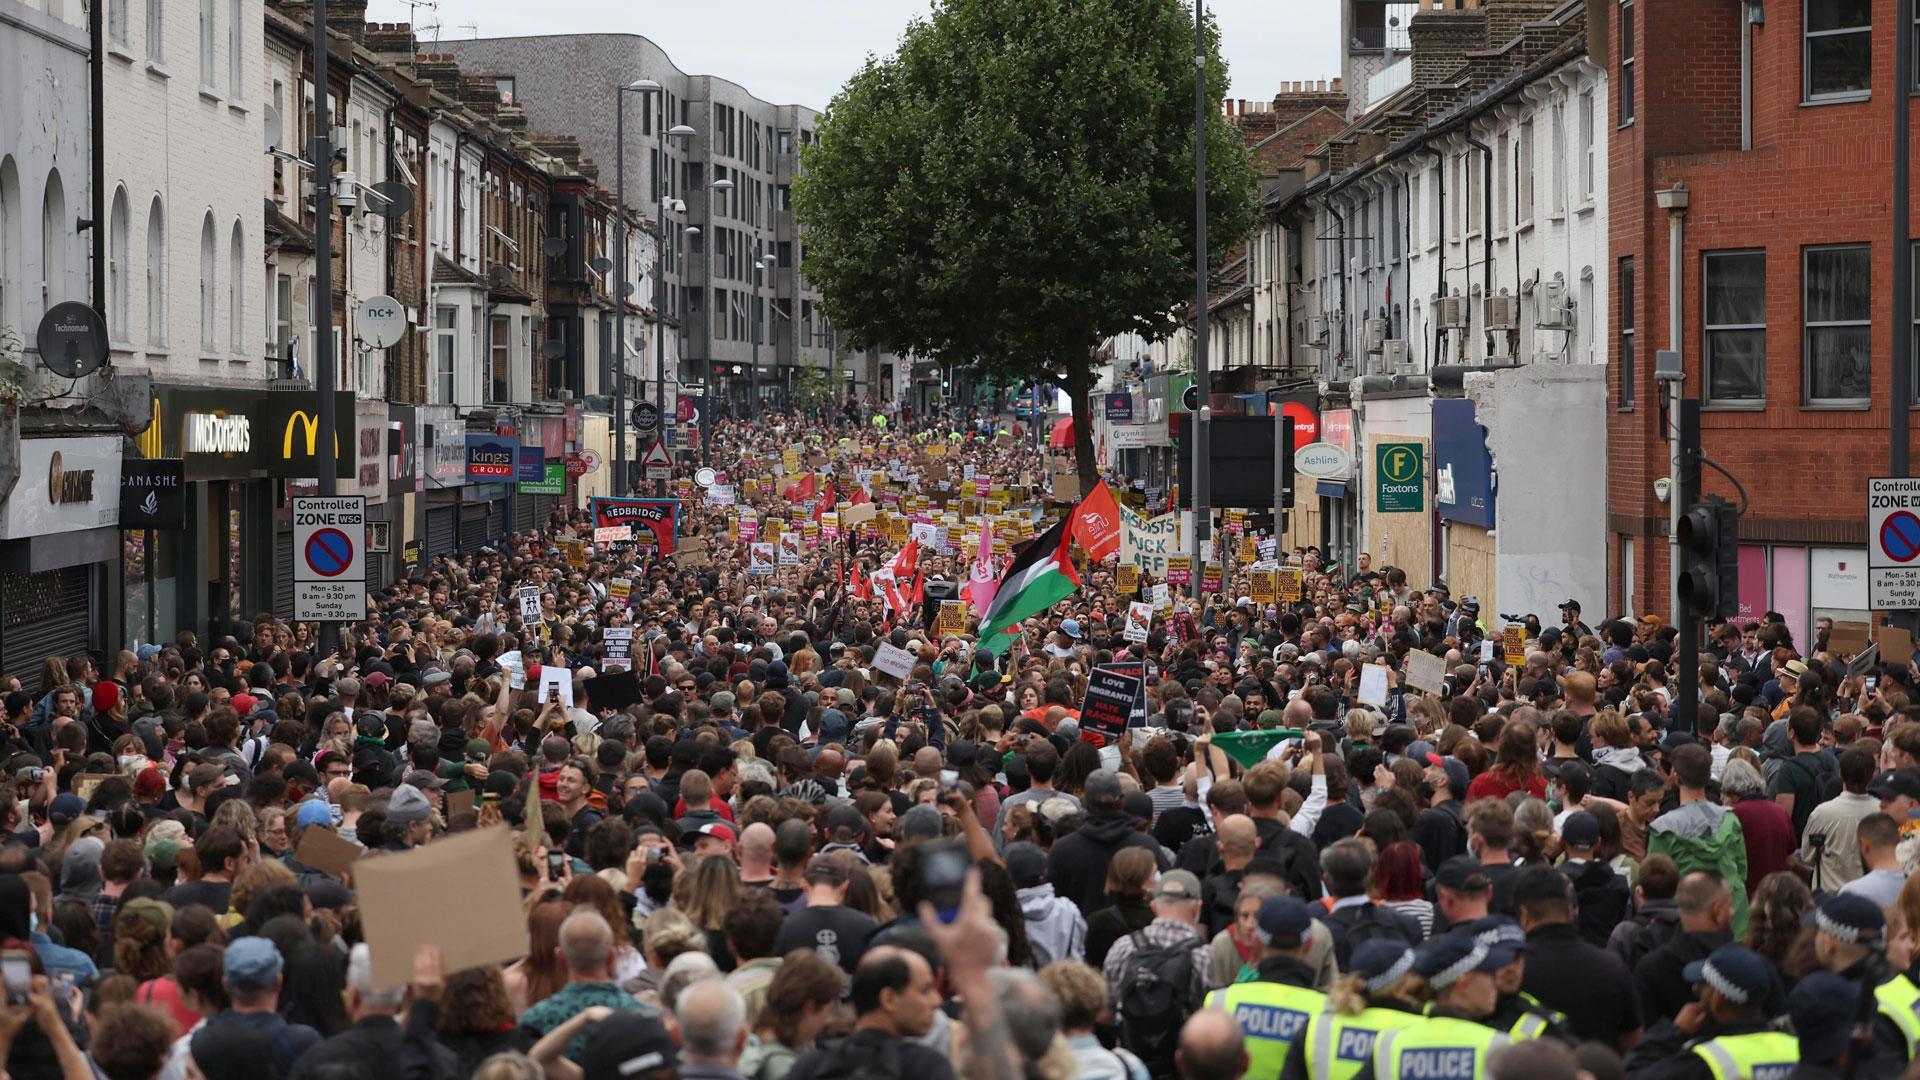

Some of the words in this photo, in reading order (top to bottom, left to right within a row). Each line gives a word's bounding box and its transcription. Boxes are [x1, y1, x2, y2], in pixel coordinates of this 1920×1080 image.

[368, 308, 394, 317] nc+
[55, 323, 89, 332] Technomate
[194, 413, 250, 453] McDonald's
[472, 448, 509, 464] kings
[1304, 456, 1338, 465] Ashlins
[1382, 484, 1419, 493] Foxtons
[298, 500, 359, 510] Controlled
[1872, 496, 1909, 508] ZONE
[296, 513, 336, 525] ZONE
[339, 514, 361, 524] WSC
[606, 507, 662, 520] REDBRIDGE
[1885, 571, 1899, 579] Mon
[1739, 604, 1751, 612] Bed
[1102, 677, 1125, 688] LOVE
[1089, 685, 1133, 702] MIGRANTS
[1095, 701, 1119, 711] HATE
[1086, 709, 1125, 725] RACISM
[1237, 1006, 1307, 1036] POLICE
[1402, 1055, 1472, 1078] POLICE
